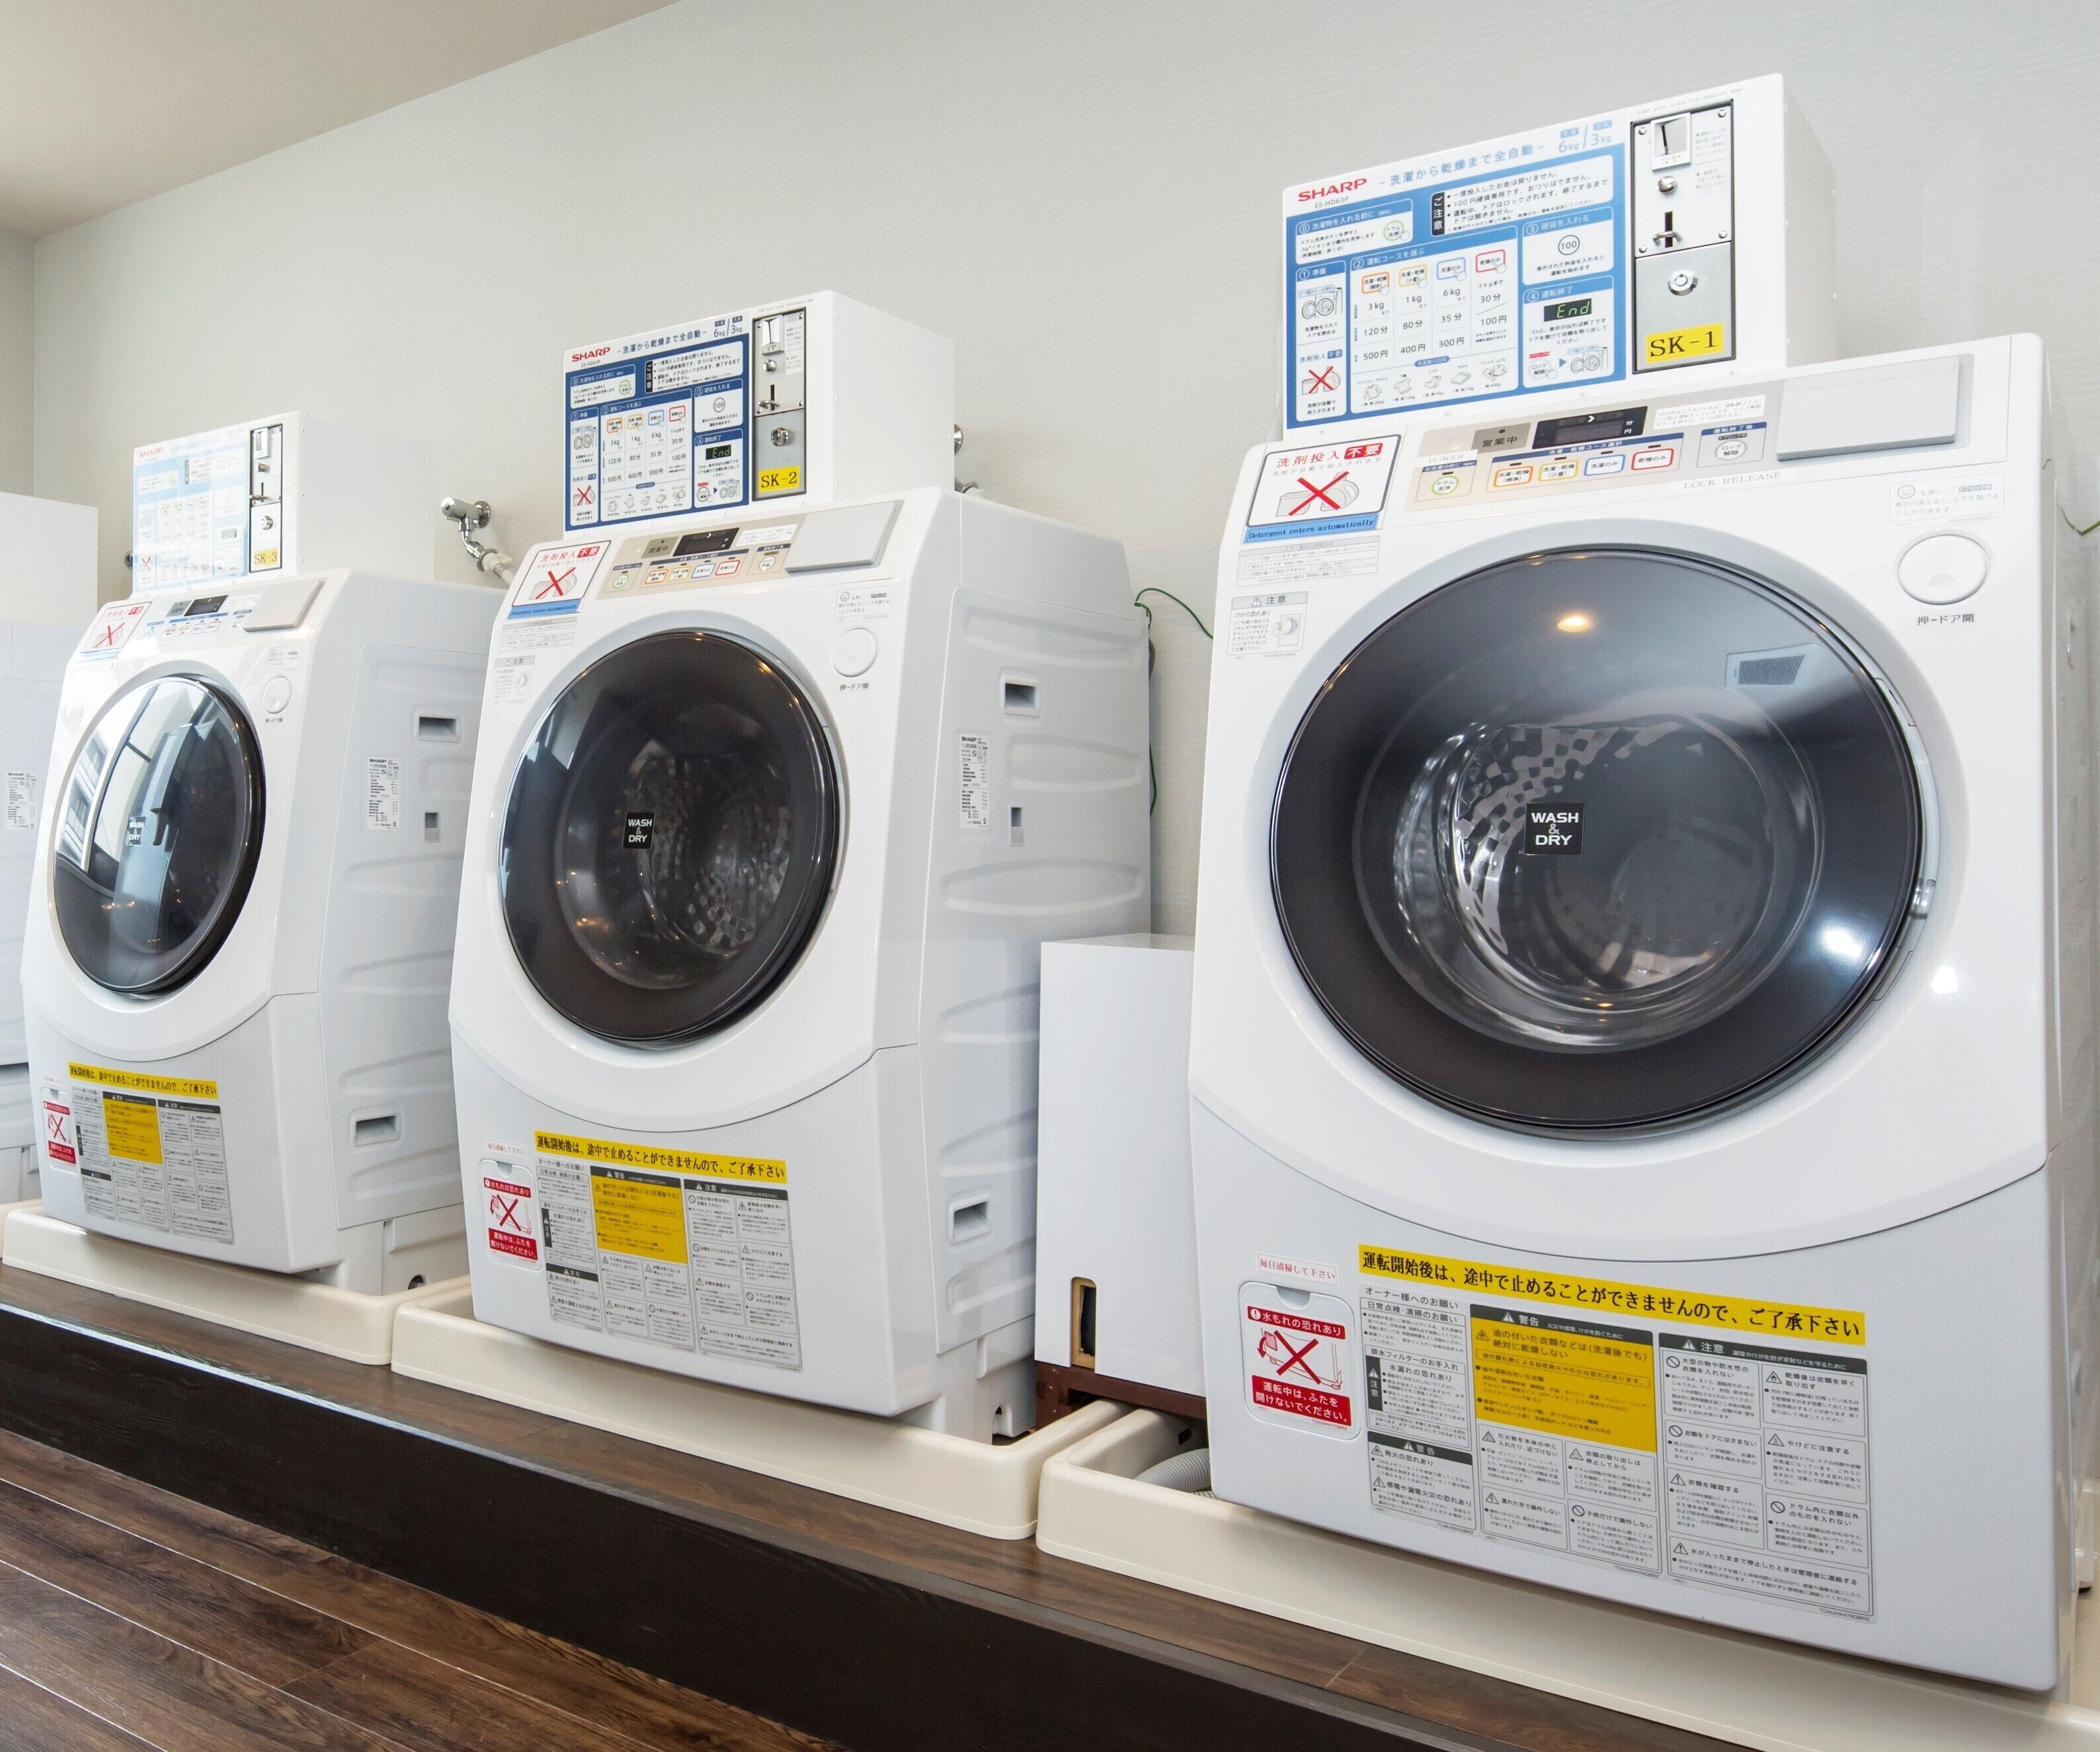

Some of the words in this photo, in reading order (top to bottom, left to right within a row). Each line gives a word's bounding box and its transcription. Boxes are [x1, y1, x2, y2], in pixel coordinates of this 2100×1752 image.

[1298, 178, 1368, 202] SHARP
[1561, 241, 1577, 250] 100
[1480, 293, 1501, 303] 30分
[1556, 301, 1590, 319] End
[1441, 313, 1462, 323] 35分
[1481, 315, 1507, 326] 100円
[1364, 325, 1388, 337] 120分
[1403, 320, 1423, 330] 80分
[1400, 343, 1426, 354] 400円
[1439, 337, 1465, 348] 300円
[1650, 331, 1717, 358] SK-1
[572, 346, 610, 362] SHARP
[1363, 350, 1388, 360] 500円
[1482, 436, 1518, 448] 営業中
[139, 448, 163, 458] SHARP
[712, 446, 731, 458] End
[1276, 451, 1340, 468] 洗剤投入
[1346, 444, 1381, 459] 不要
[1429, 454, 1465, 463] POWER
[1638, 454, 1666, 463] 乾燥のみ
[761, 471, 797, 489] SK-2
[1683, 479, 1716, 489] LOCK
[1722, 471, 1781, 485] RELEASE
[1248, 529, 1286, 539] Detergent
[1289, 526, 1314, 534] enters
[1317, 519, 1375, 532] automatically
[254, 551, 277, 564] SK-3
[1266, 596, 1287, 605] 注意
[1531, 813, 1579, 823] WASH
[1548, 823, 1560, 835] &
[1535, 835, 1573, 846] DRY
[537, 1135, 785, 1179] 運転開始後は、途中で止めることができませんので、ご了承下さい
[1260, 1259, 1335, 1280] 毎日清掃して下さい
[1362, 1250, 1860, 1338] 運転開始後は、途中で止めることができませんので、ご了承下さい
[1365, 1287, 1459, 1309] オーナー様へのお願い
[1263, 1312, 1342, 1336] 水もれの恐れあり
[1519, 1315, 1539, 1327] 警告
[1493, 1339, 1568, 1358] 絶対に乾燥しない
[1701, 1342, 1724, 1354] 注意
[1390, 1365, 1452, 1382] 水漏れの恐れあり
[1785, 1380, 1816, 1390] 取り出す
[1263, 1381, 1338, 1408] 運転中は、ふたを
[1256, 1392, 1348, 1423] 開けないでください。
